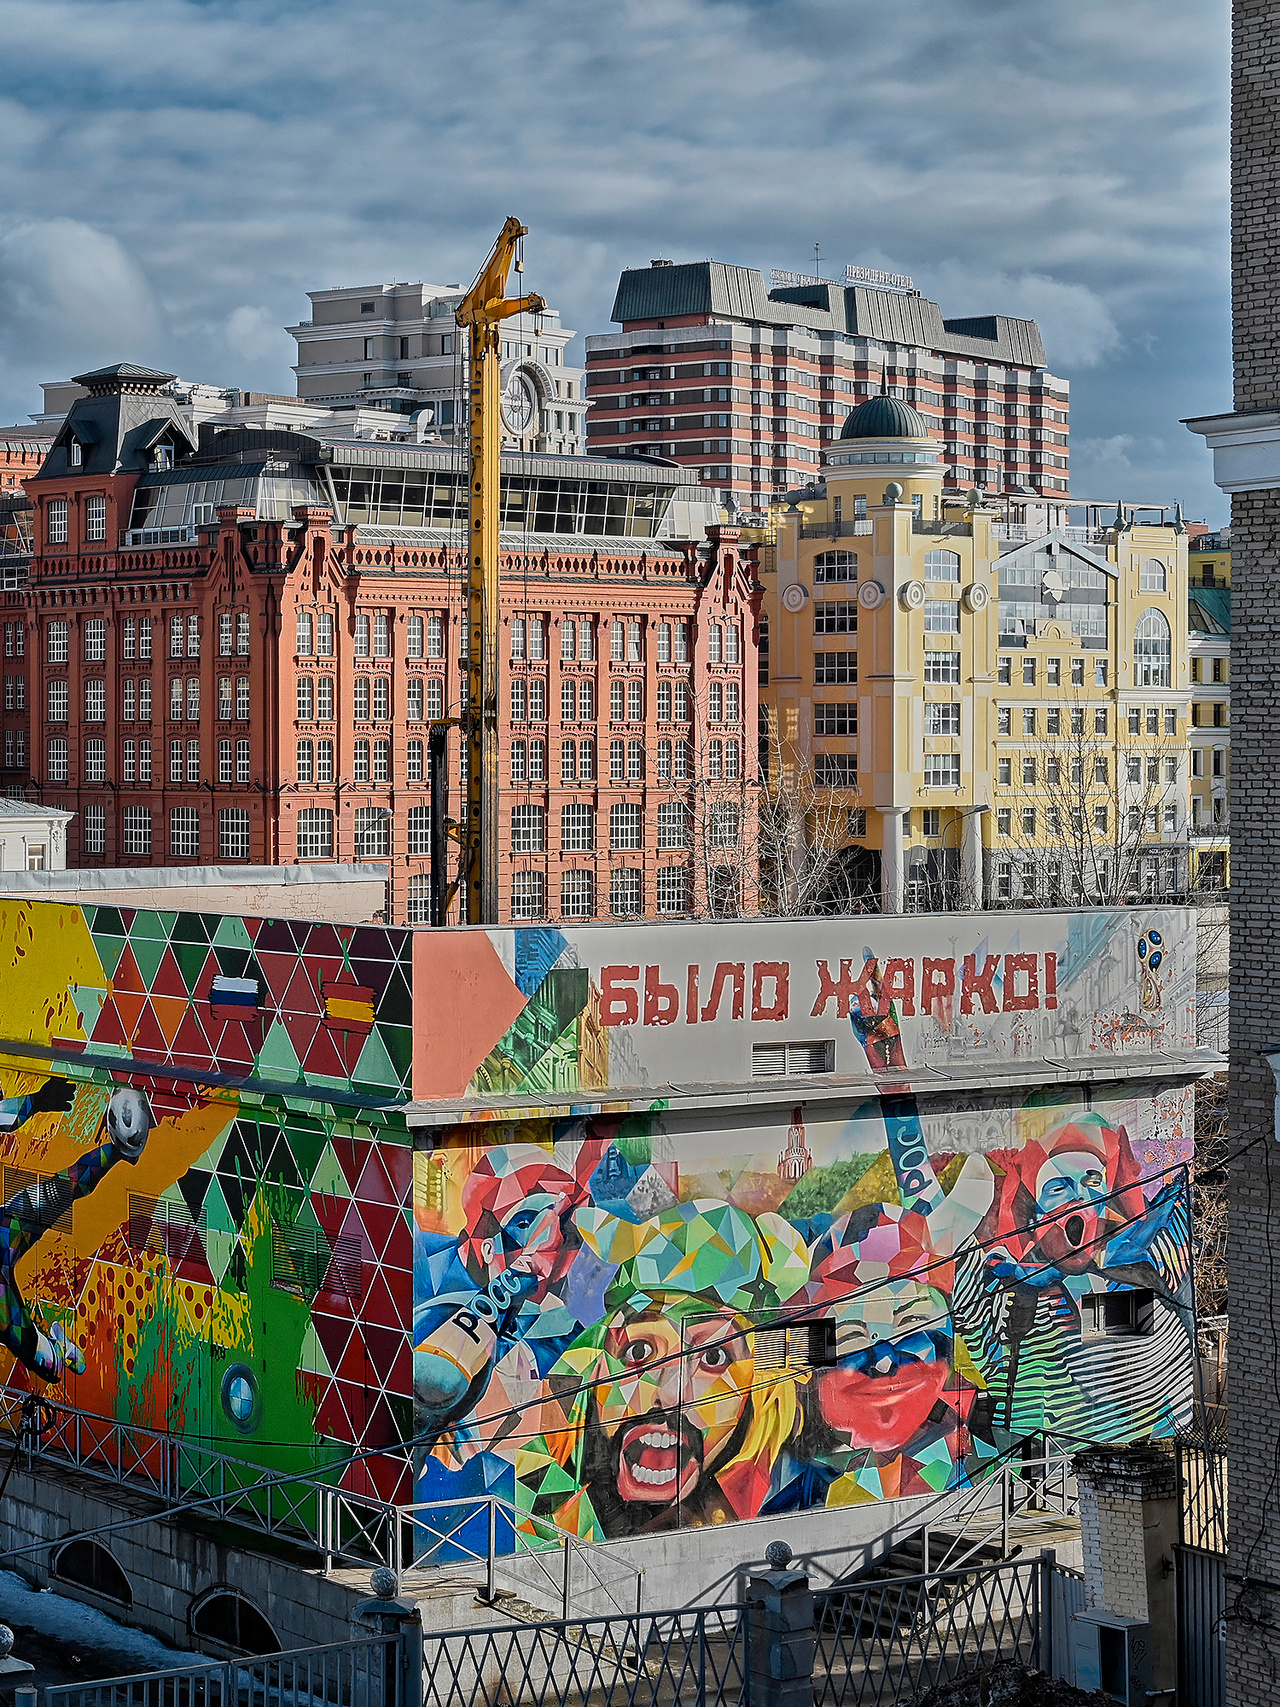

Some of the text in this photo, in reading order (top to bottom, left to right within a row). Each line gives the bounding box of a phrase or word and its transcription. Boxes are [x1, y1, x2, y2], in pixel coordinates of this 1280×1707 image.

[845, 264, 914, 289] ПРЕЗИДЕНТ-ОТЕЛЬ
[599, 952, 1058, 1026] БЫЛО ЖАРКО!
